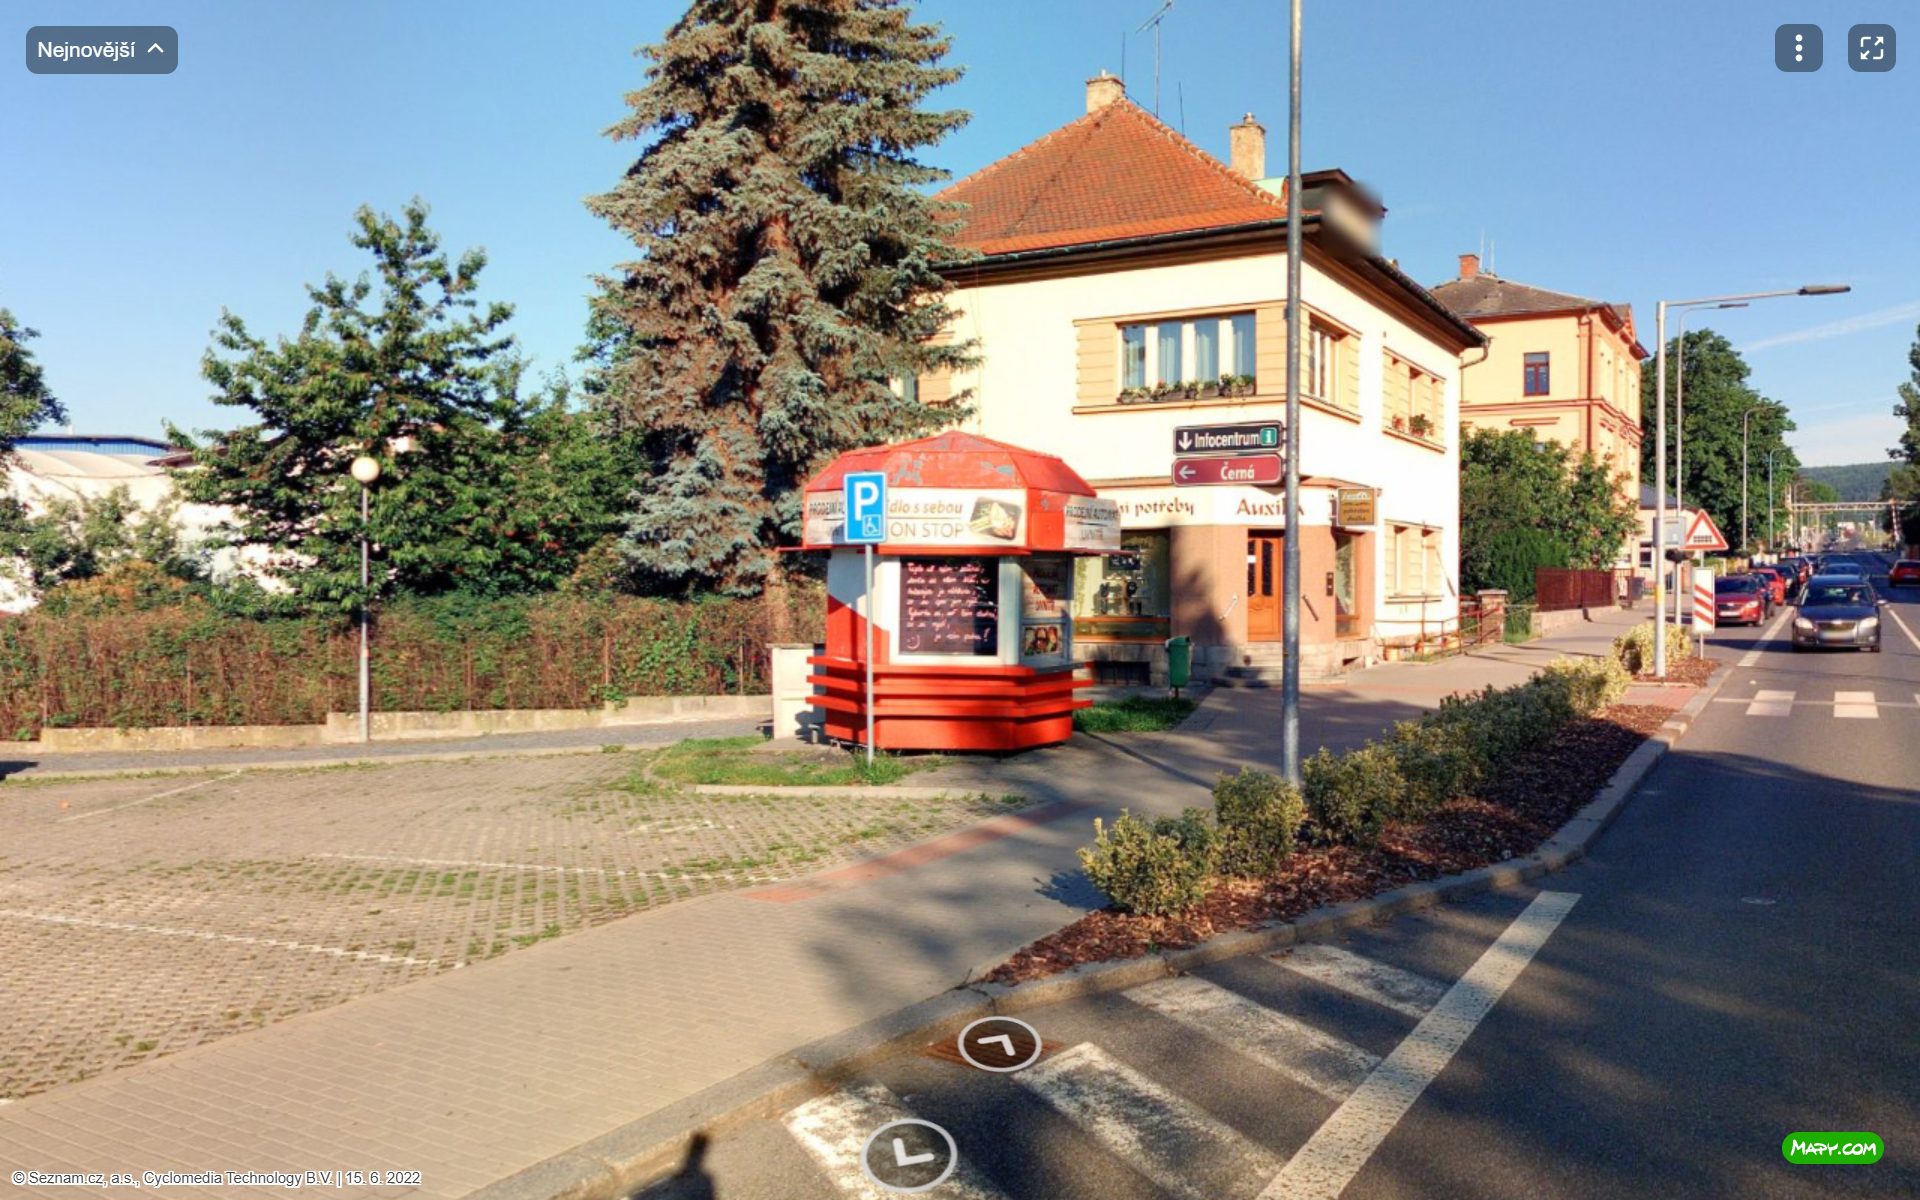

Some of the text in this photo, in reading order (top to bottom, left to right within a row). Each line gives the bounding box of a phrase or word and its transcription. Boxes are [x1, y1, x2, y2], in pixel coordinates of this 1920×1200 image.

[1194, 431, 1260, 448] Infocentrum
[1220, 460, 1255, 481] Černá
[854, 481, 879, 521] P
[913, 503, 920, 514] s
[922, 499, 963, 514] sebou
[1135, 496, 1194, 518] potřeby
[890, 522, 964, 538] ON STOP
